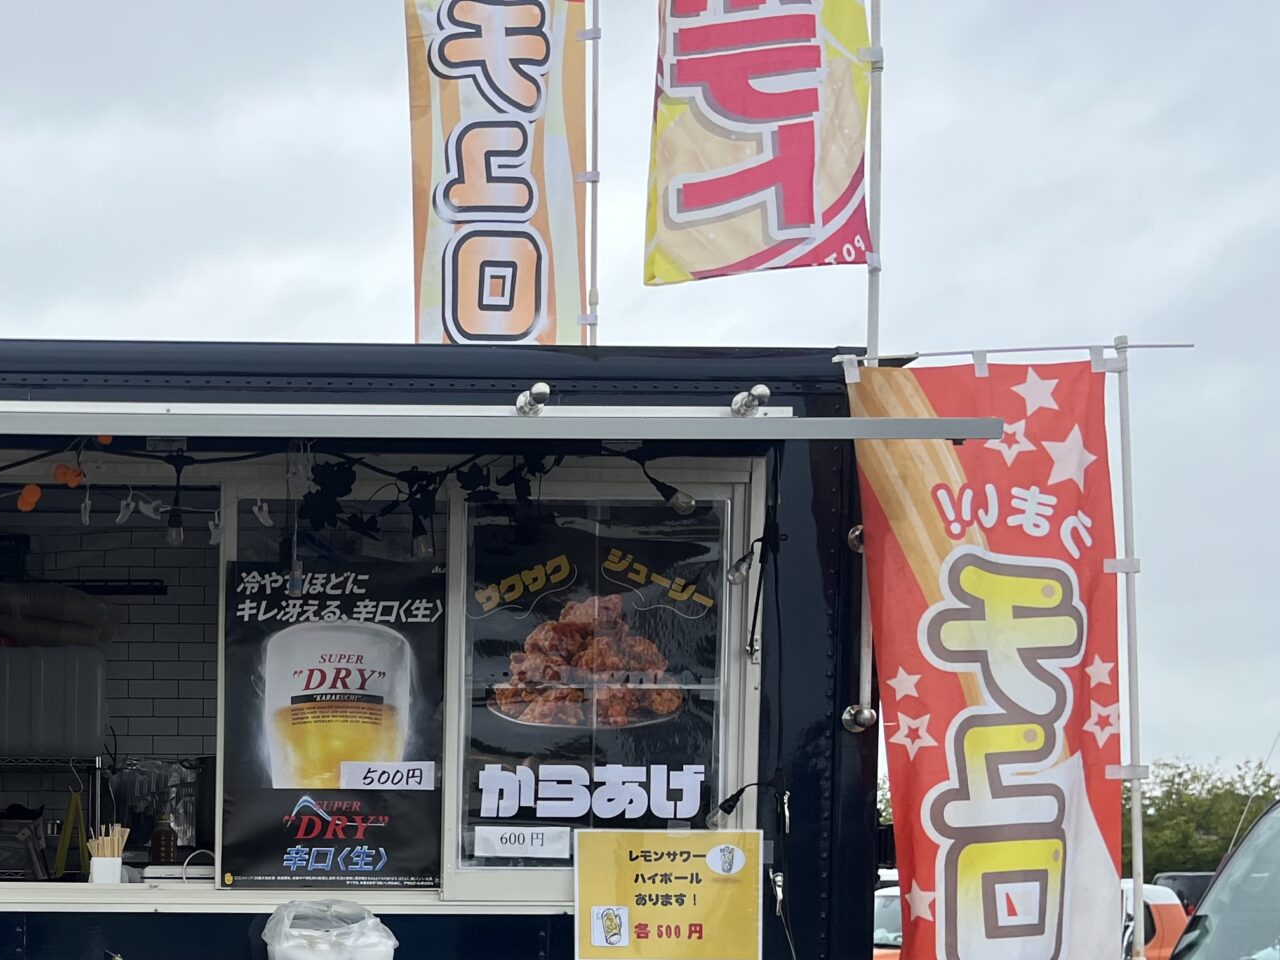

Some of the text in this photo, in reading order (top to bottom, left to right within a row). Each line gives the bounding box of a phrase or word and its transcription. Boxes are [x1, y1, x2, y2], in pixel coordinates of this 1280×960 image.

[475, 553, 573, 612] サクサク
[604, 547, 714, 607] ジューシー
[318, 653, 364, 665] SUPER
[362, 767, 423, 786] 500円
[479, 764, 705, 819] からあげ
[315, 800, 361, 812] SUPER
[628, 849, 707, 863] レモンサワー
[634, 871, 702, 885] ハイボール
